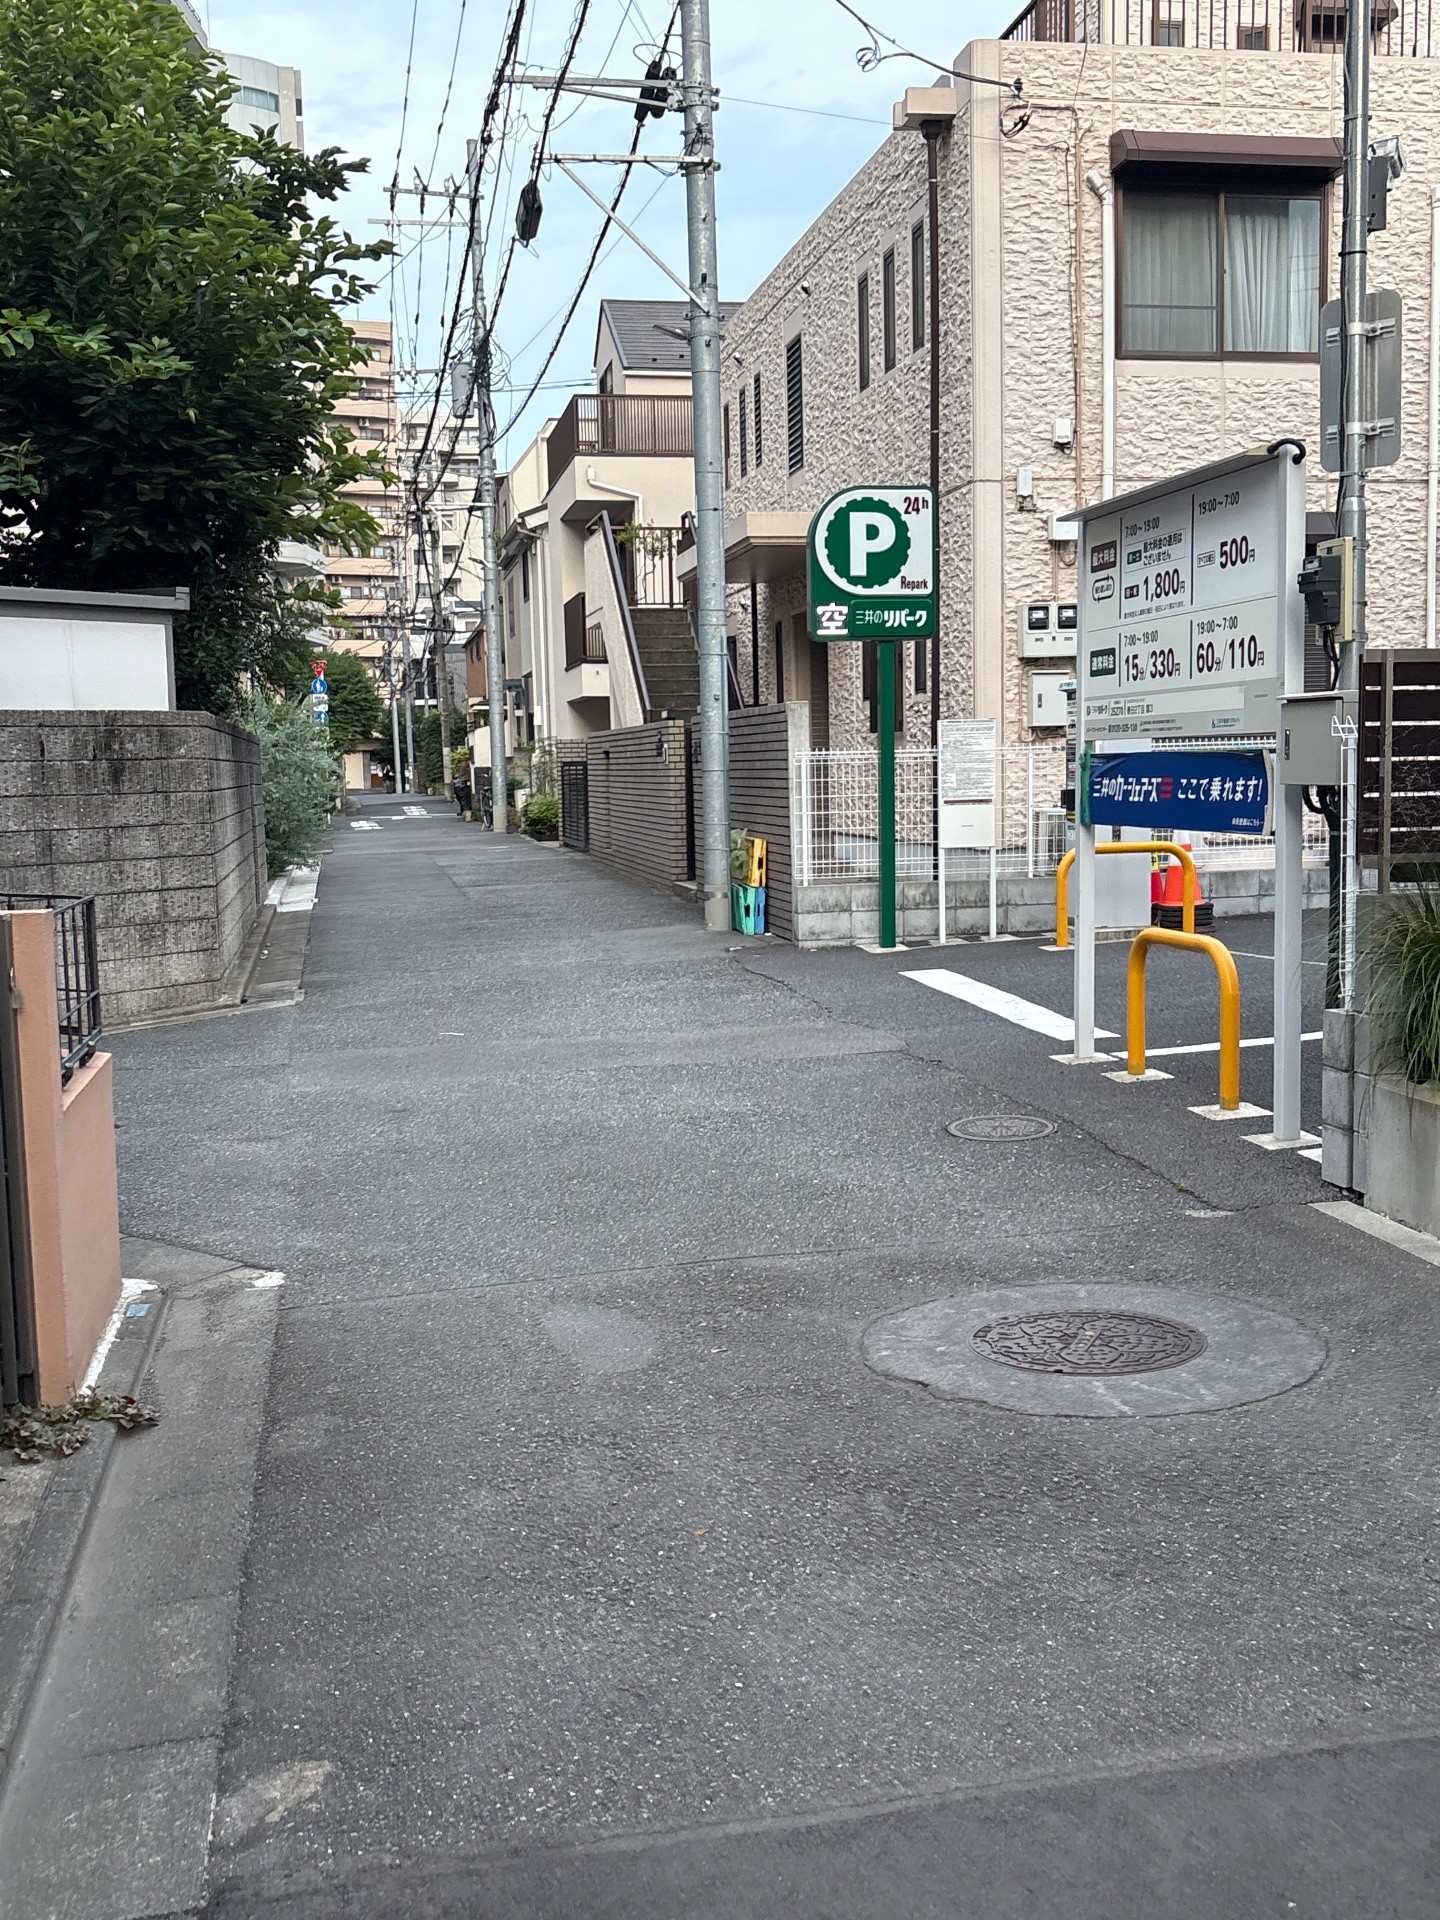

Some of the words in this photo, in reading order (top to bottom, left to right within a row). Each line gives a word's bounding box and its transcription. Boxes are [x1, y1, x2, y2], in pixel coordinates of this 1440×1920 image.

[903, 496, 929, 515] 24h
[849, 511, 896, 577] P
[1220, 535, 1256, 570] 500円
[900, 576, 928, 591] Repark
[1143, 568, 1185, 602] 1,800円
[816, 602, 848, 635] 空
[855, 608, 927, 628] 三井のリパーク
[1093, 774, 1162, 802] 三井のカーシェアーズ
